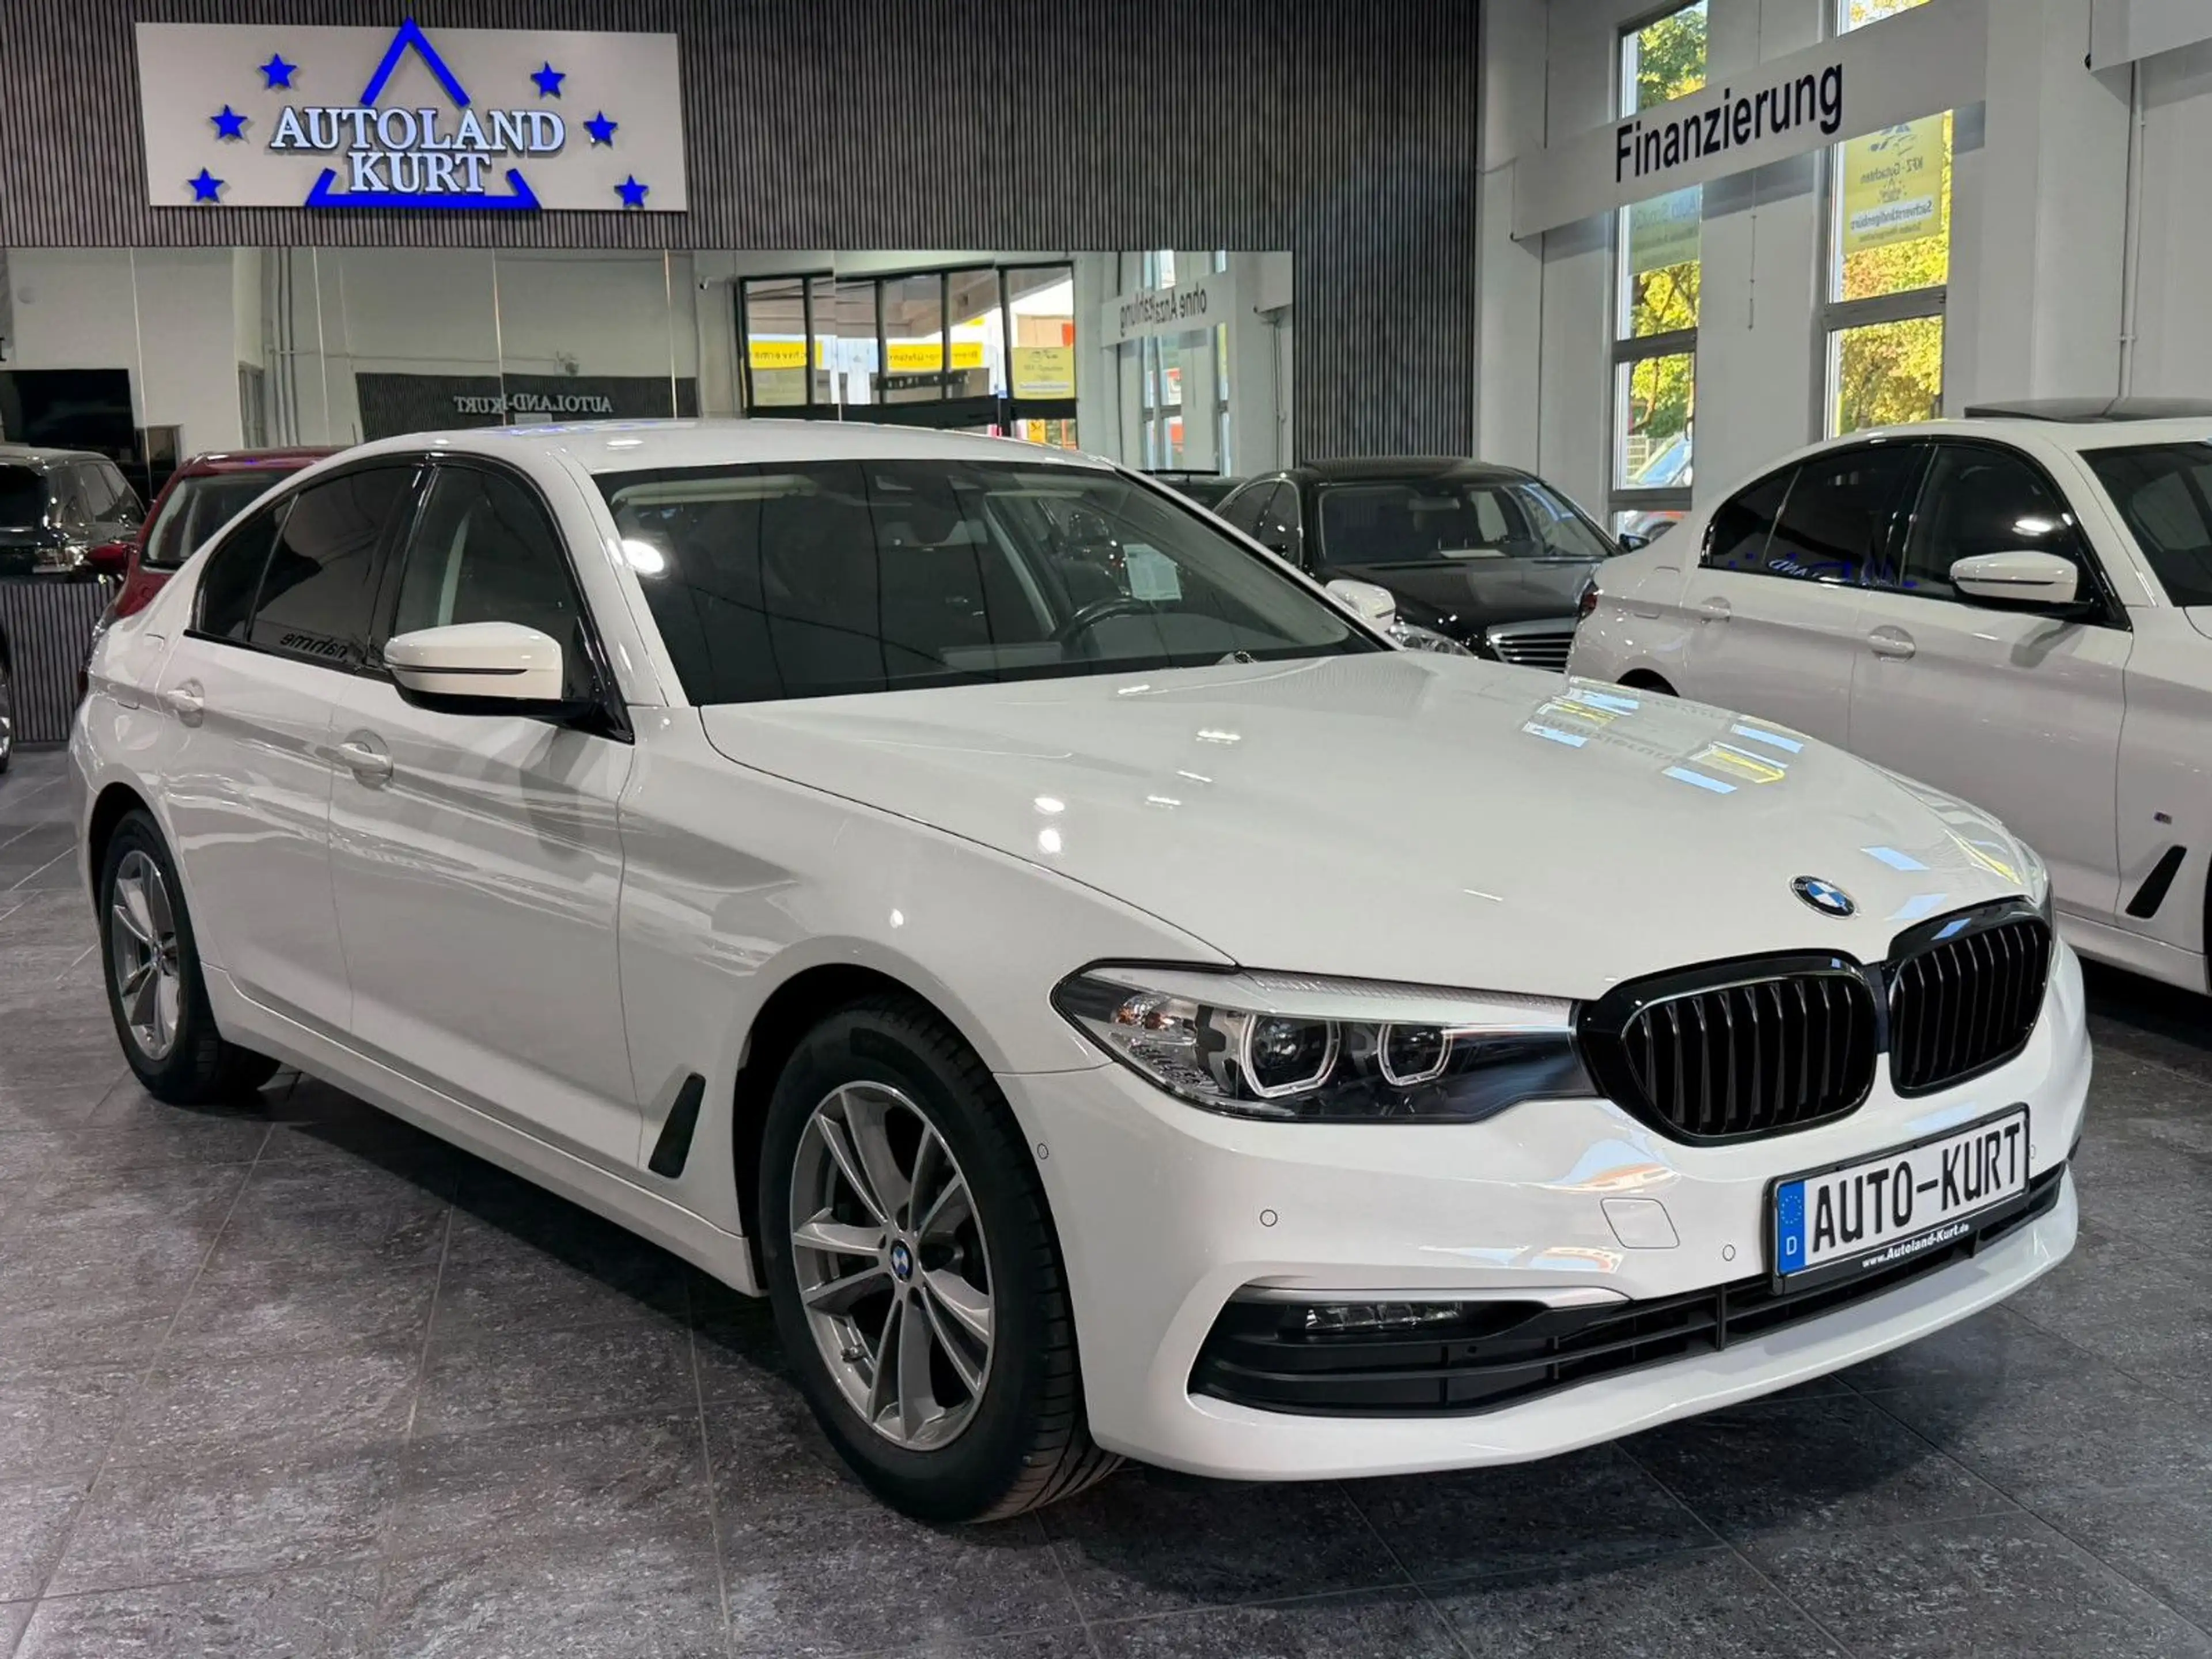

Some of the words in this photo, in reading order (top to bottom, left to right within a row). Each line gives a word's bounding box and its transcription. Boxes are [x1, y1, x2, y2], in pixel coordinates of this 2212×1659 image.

[269, 106, 566, 153] AUTOLAND
[1615, 62, 1843, 183] Finanzierung
[347, 150, 491, 195] KURT
[1813, 1122, 2020, 1253] AUTO-KURT
[1786, 1236, 1797, 1255] D
